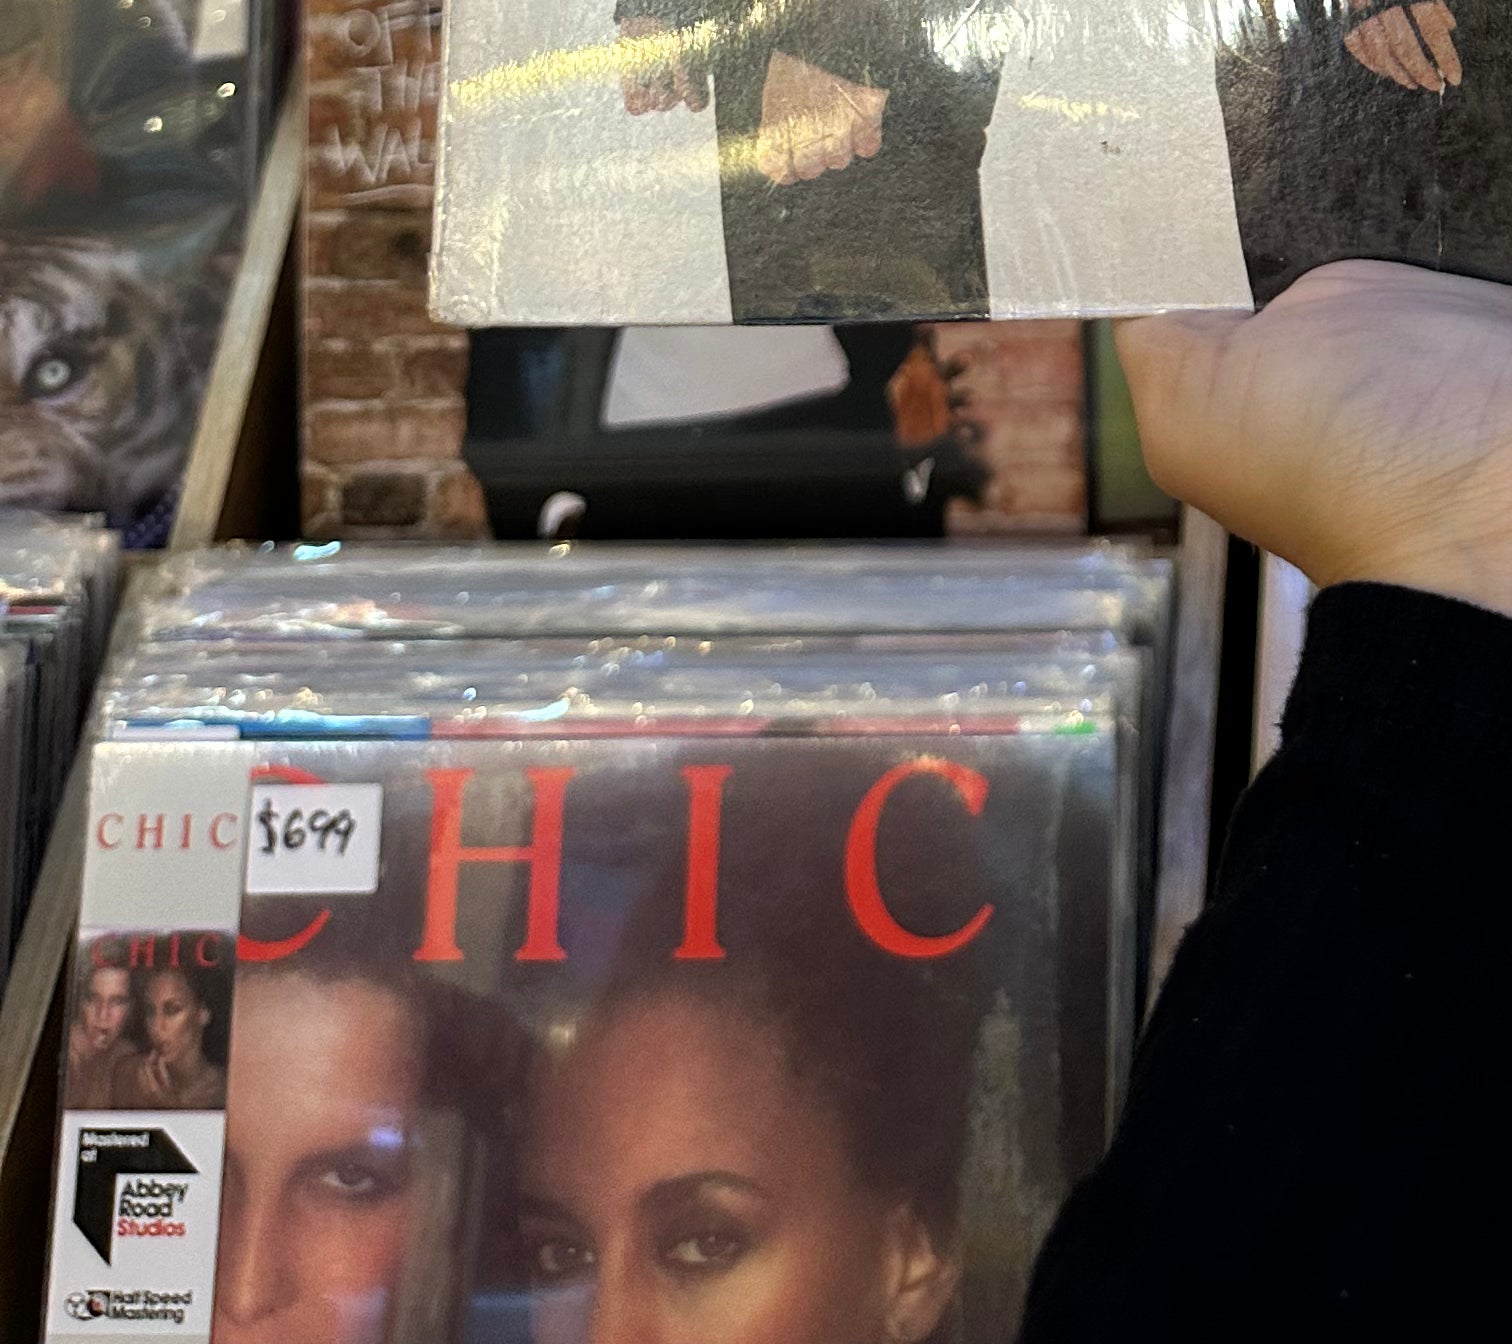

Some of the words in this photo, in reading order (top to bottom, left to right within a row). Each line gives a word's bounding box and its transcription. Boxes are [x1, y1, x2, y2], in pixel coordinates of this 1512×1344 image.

[321, 116, 436, 188] WAL
[96, 811, 239, 850] CHIC
[258, 797, 357, 857] $699
[91, 932, 221, 969] CHIC
[82, 1131, 151, 1148] Mastered
[121, 1178, 189, 1202] Abbey
[118, 1198, 173, 1218] Road
[117, 1218, 187, 1237] Studios
[112, 1288, 140, 1304] Half
[143, 1288, 193, 1306] Speed
[110, 1305, 186, 1324] Mastering
